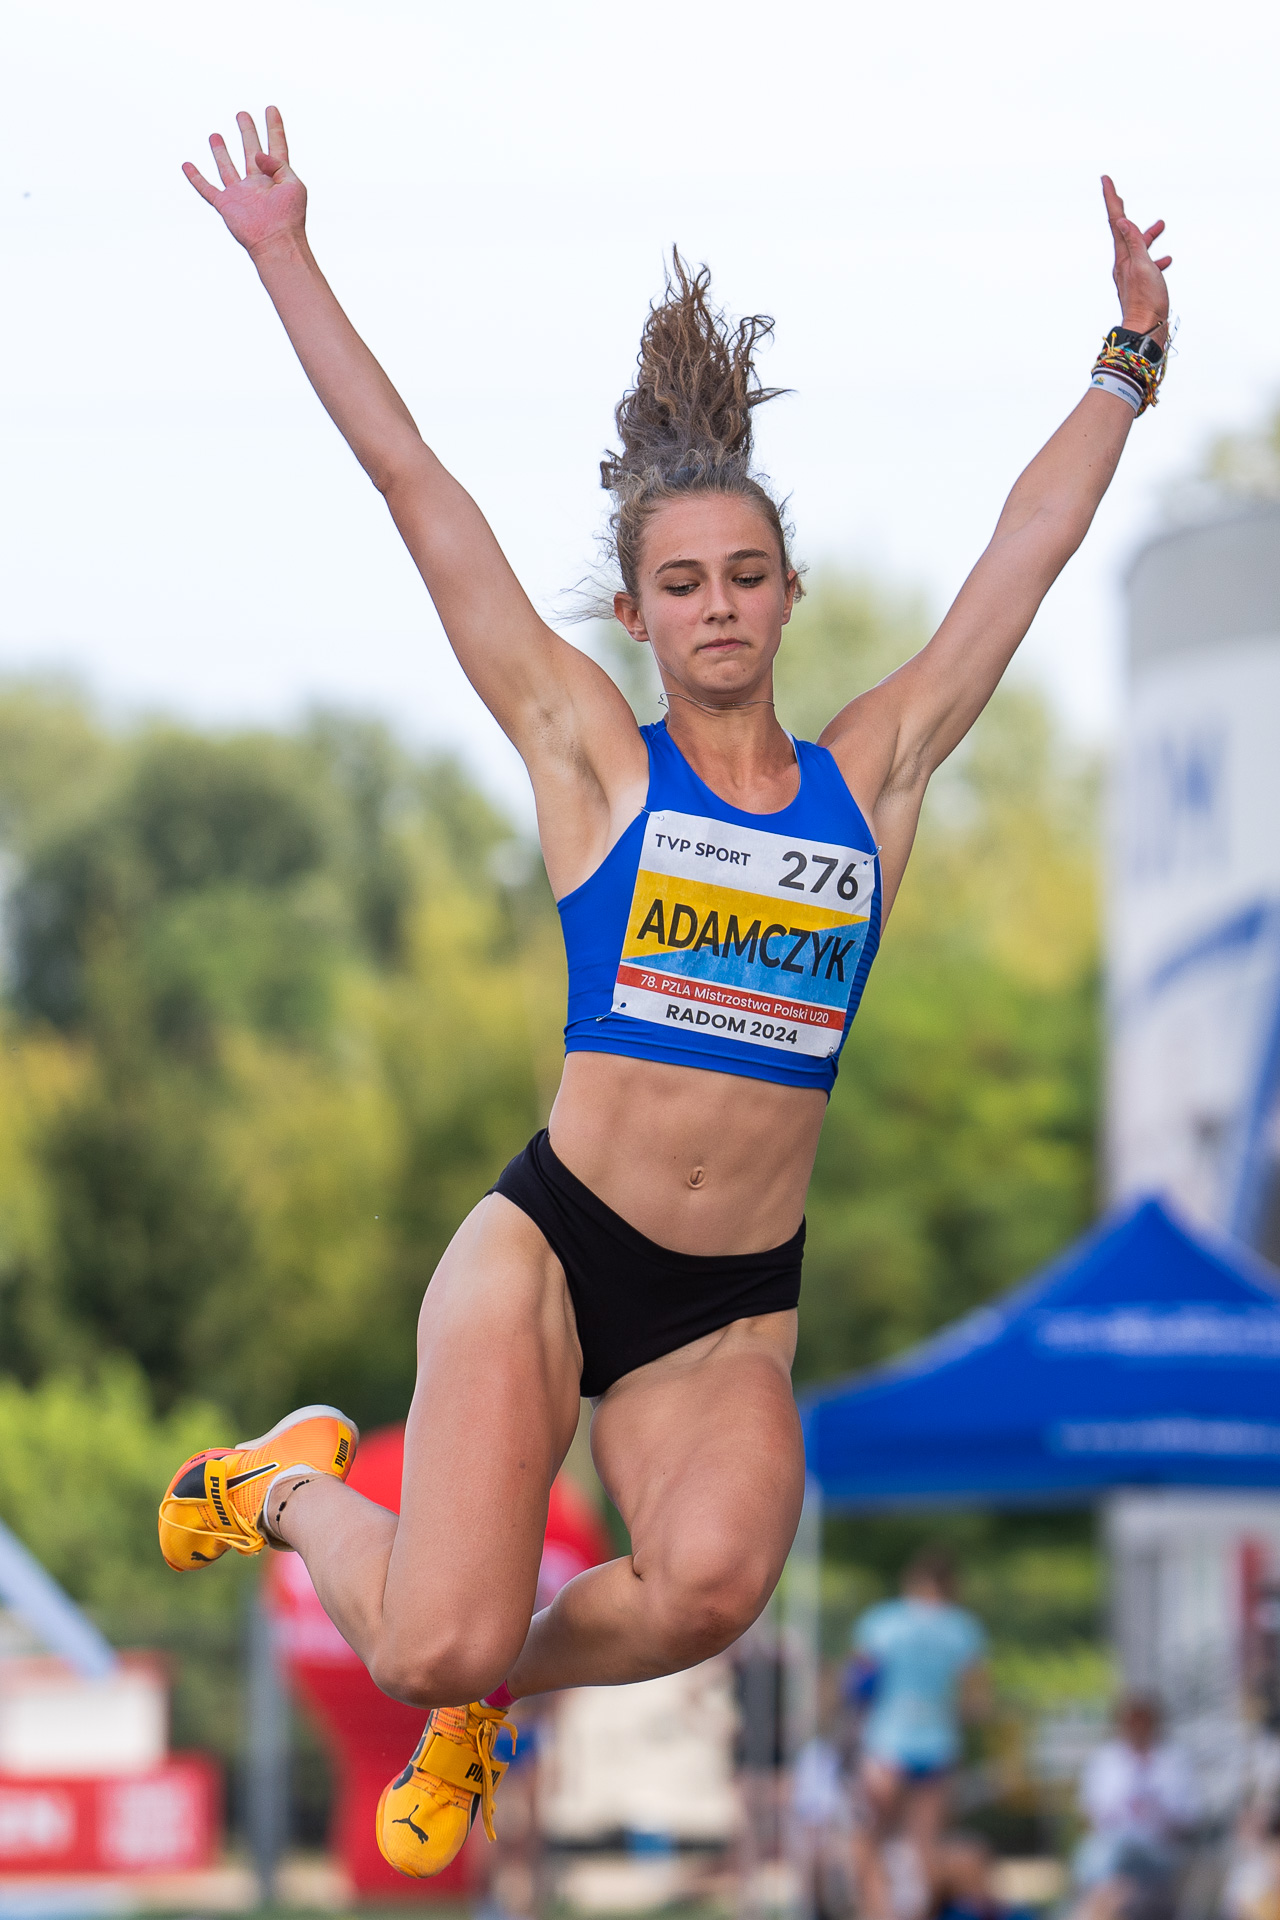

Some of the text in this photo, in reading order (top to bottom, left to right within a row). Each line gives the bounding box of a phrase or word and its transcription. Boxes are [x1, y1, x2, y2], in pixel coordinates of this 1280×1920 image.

[655, 833, 751, 866] TVP SPORT
[778, 850, 859, 901] 276
[636, 899, 855, 982] ADAMCZYK
[640, 974, 829, 1025] 78. PZLA Mistrzostwa Polski U20
[665, 1004, 798, 1044] RADOM 2024
[334, 1438, 350, 1468] PUMA
[210, 1476, 232, 1526] PUMA
